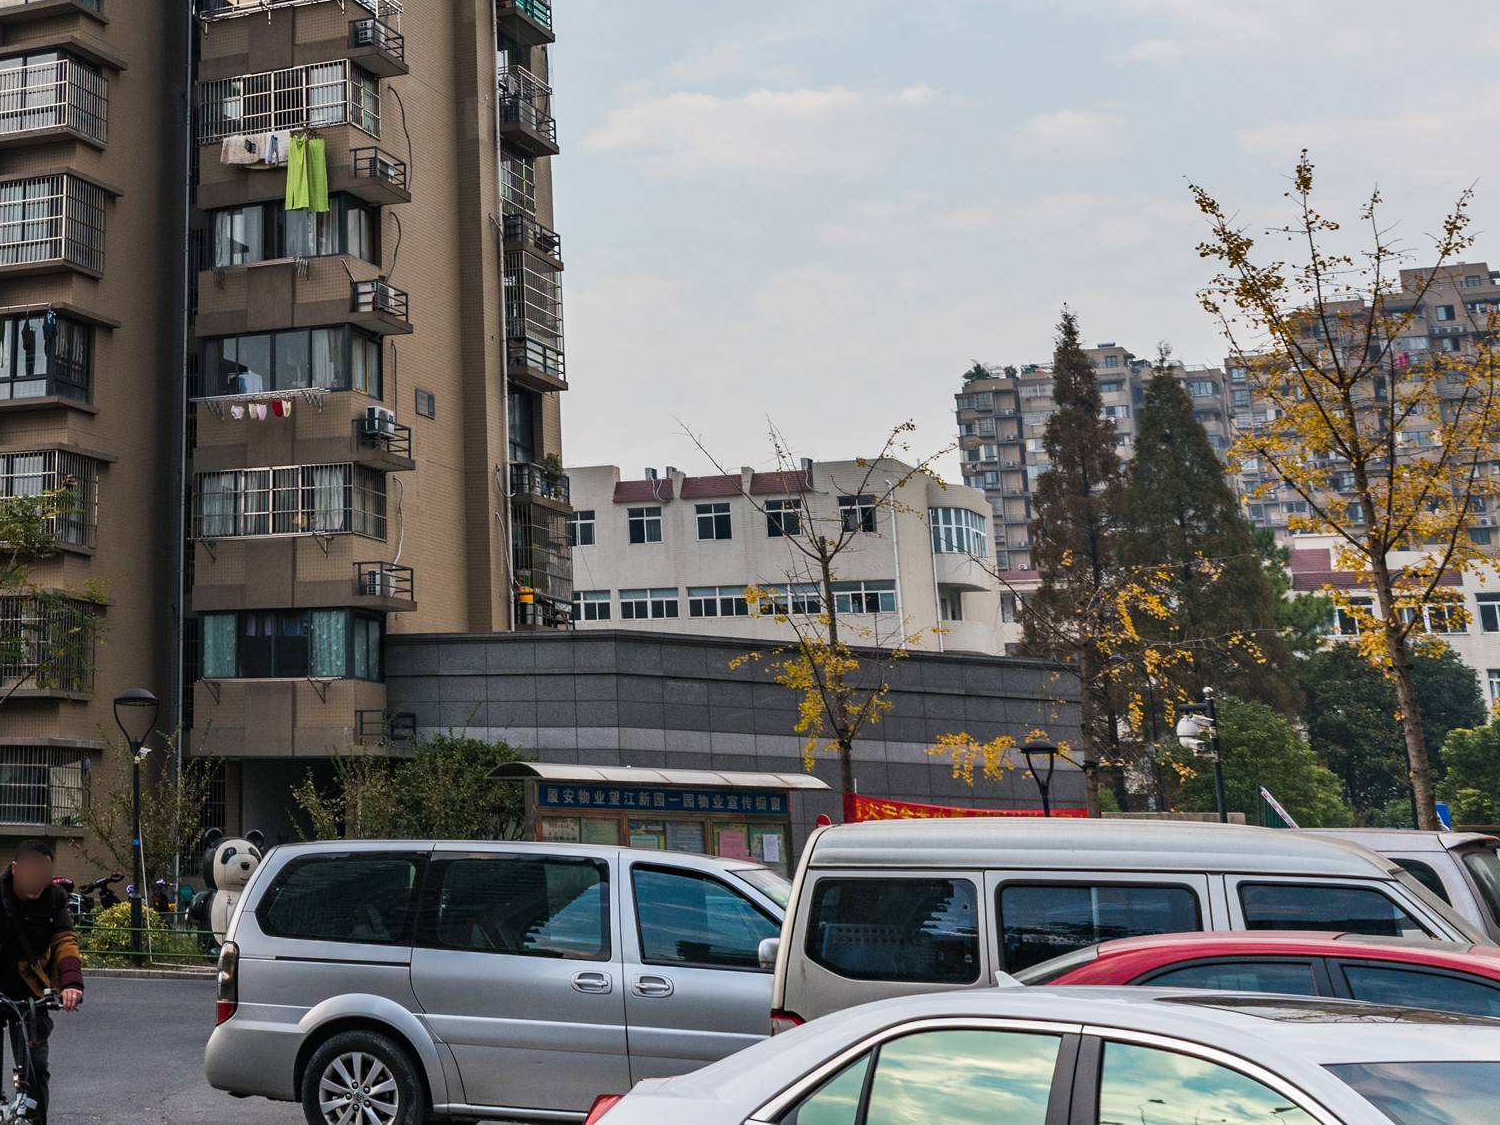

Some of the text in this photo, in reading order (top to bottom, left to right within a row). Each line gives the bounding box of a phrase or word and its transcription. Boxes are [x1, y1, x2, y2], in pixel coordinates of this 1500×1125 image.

[547, 788, 781, 811] 厦安物业望江新园一园物业宣传橱窗
